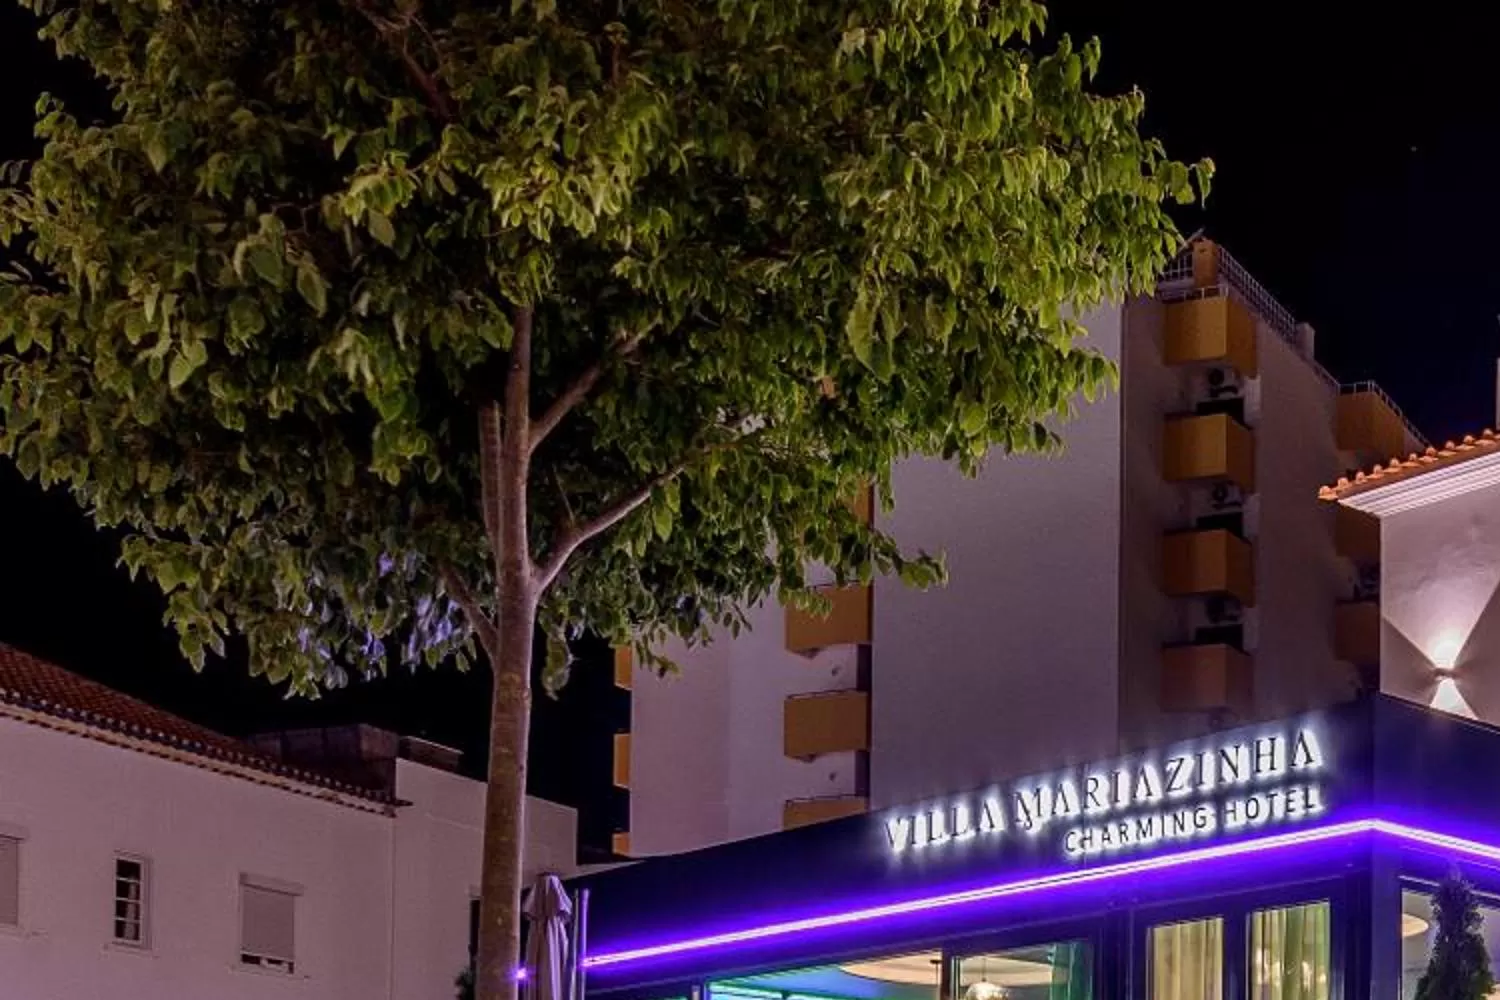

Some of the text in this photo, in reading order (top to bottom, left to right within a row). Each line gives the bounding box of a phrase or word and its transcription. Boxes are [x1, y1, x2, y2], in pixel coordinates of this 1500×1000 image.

[884, 730, 1316, 850] VILLA MARIAZINHA
[1064, 786, 1316, 853] CHARMING HOTEL
